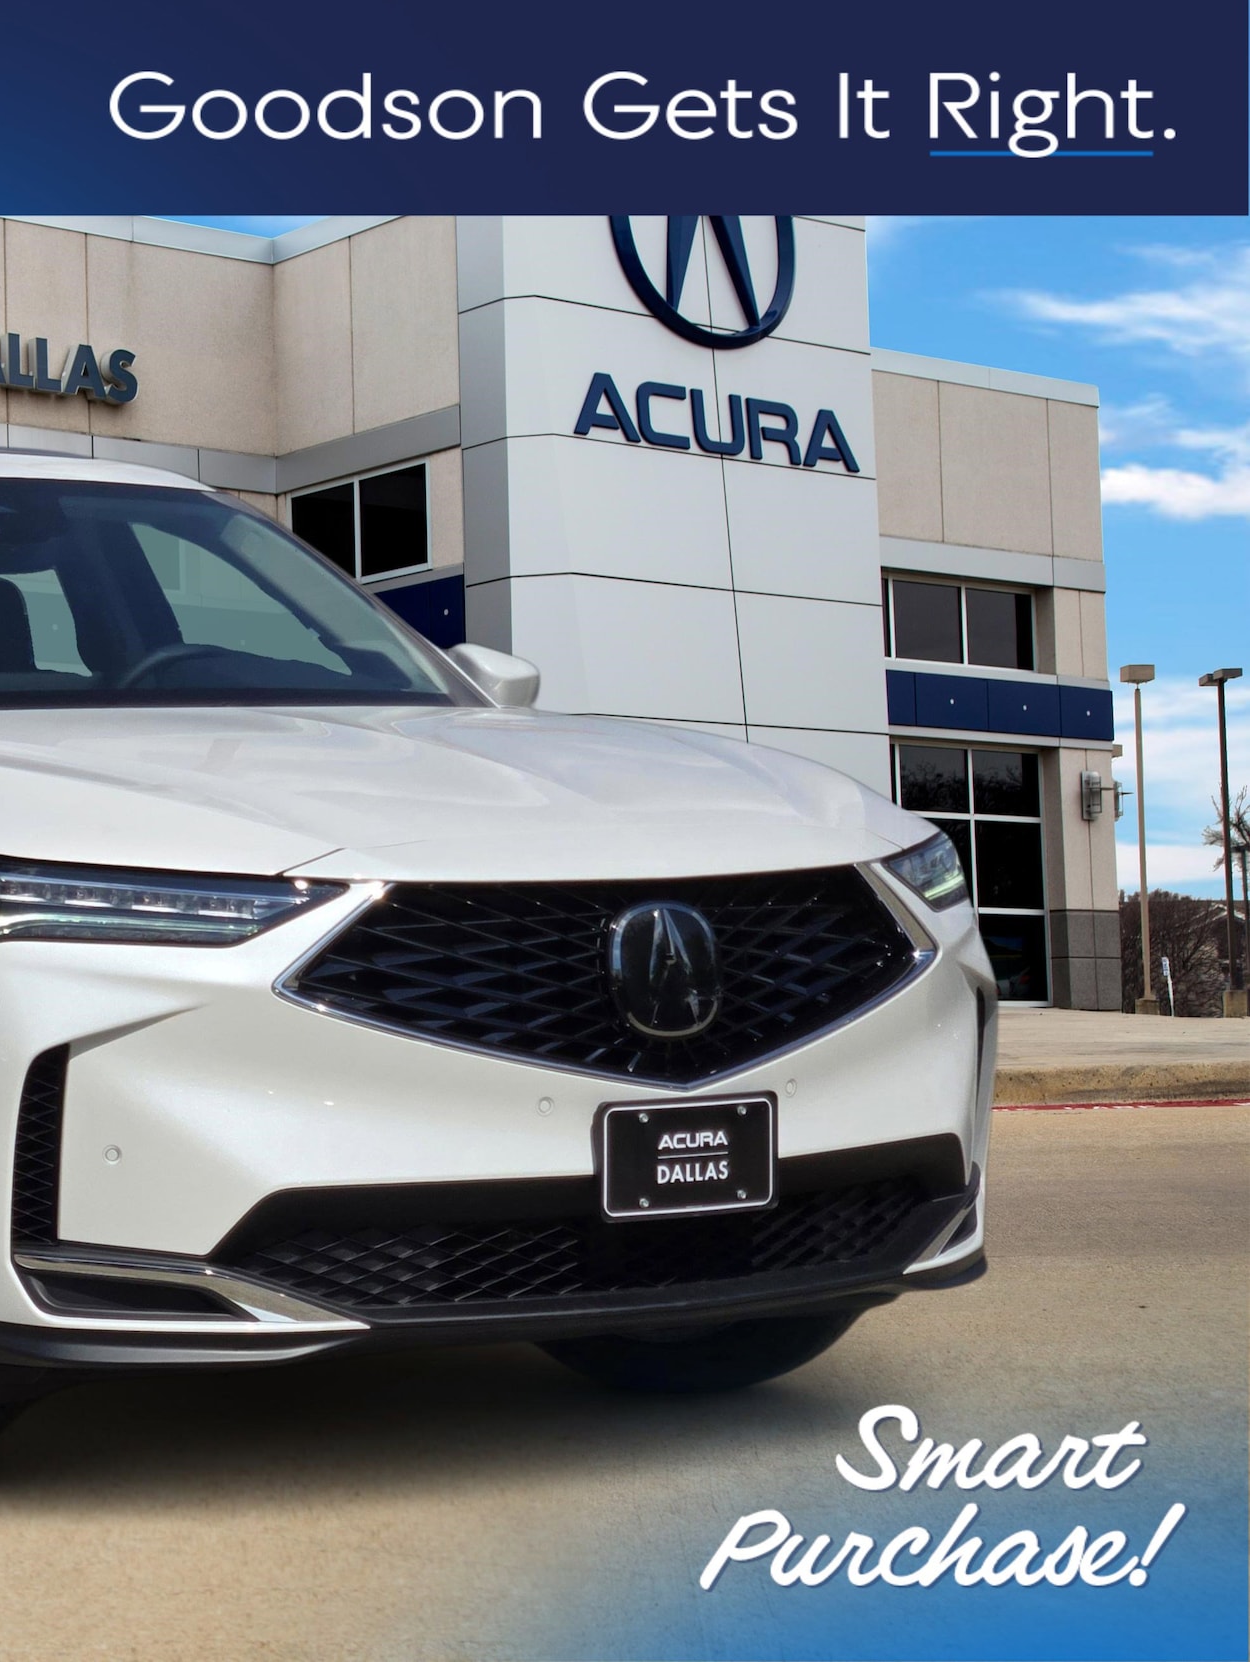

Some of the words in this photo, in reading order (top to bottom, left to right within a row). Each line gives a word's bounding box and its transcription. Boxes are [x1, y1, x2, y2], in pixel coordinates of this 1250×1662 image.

[573, 371, 860, 475] ACURA
[657, 1130, 729, 1150] ACURA
[656, 1160, 729, 1184] DALLAS
